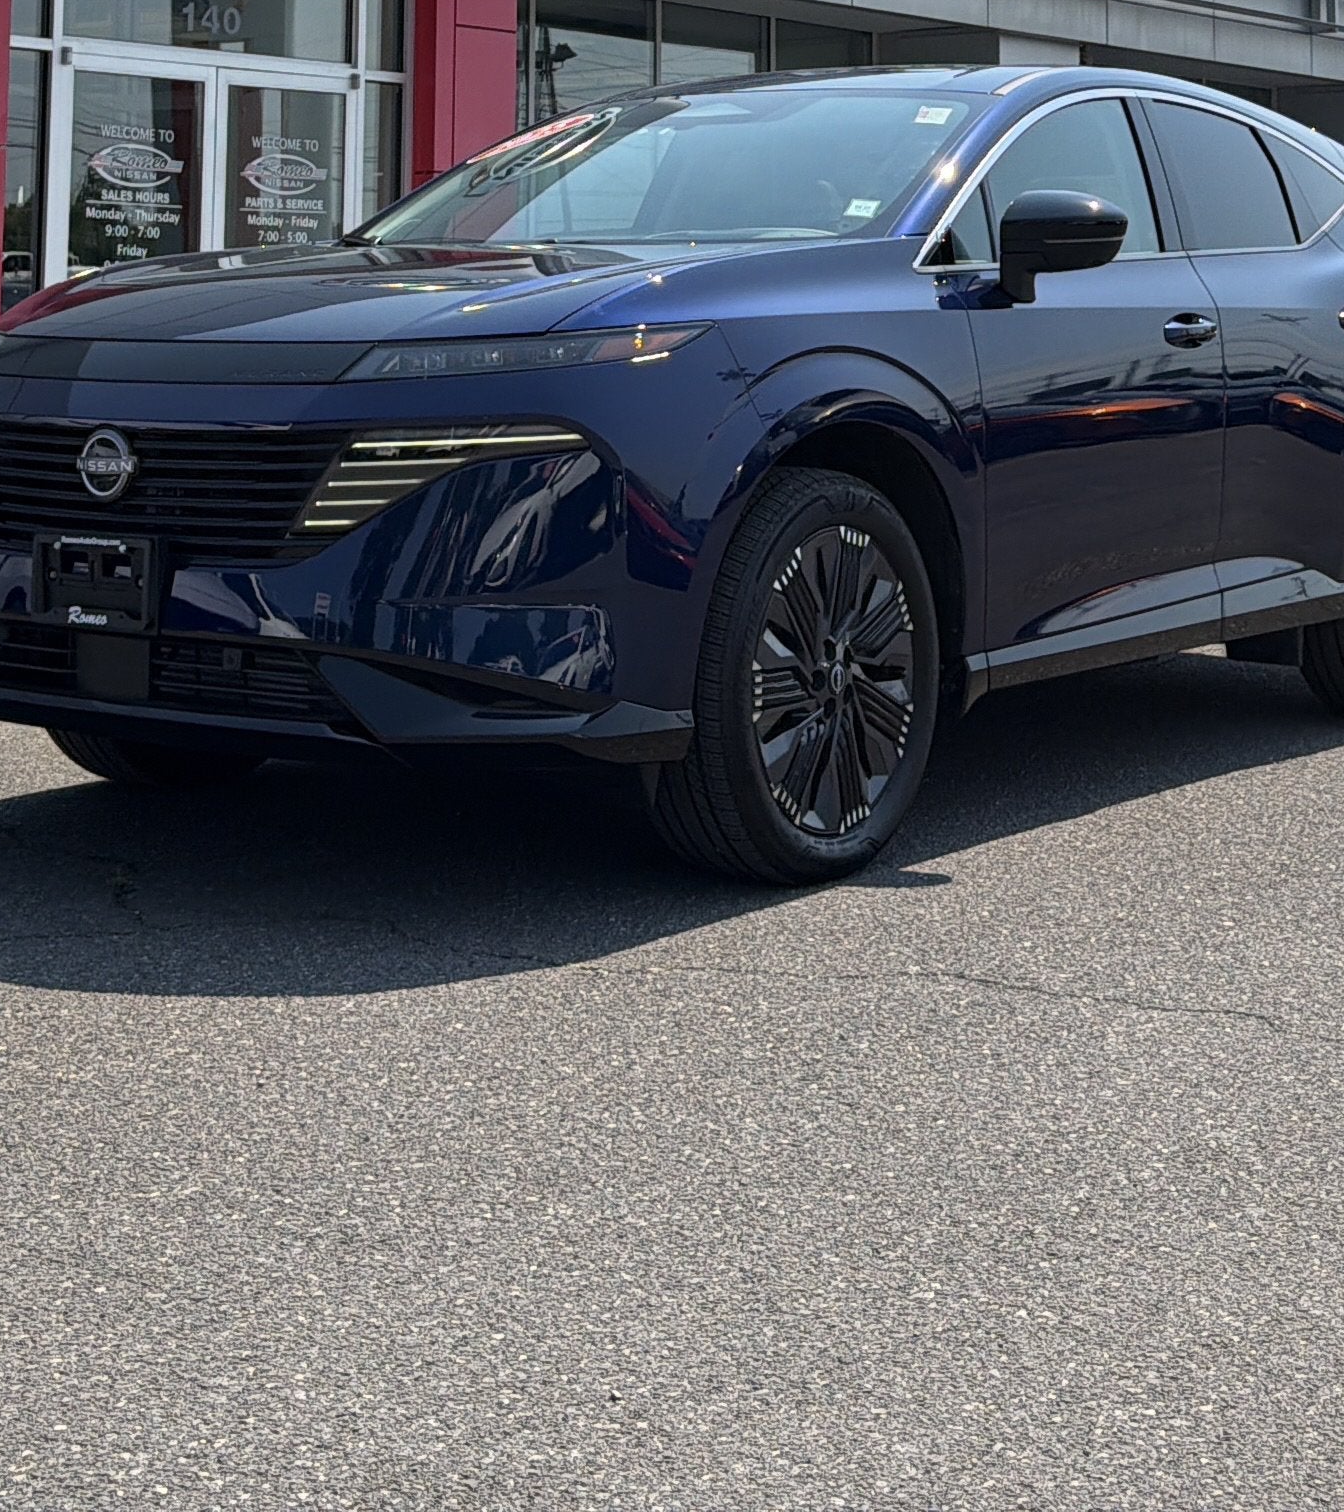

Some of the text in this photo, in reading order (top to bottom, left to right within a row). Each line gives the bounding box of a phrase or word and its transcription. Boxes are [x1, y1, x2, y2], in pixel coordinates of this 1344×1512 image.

[182, 2, 241, 35] 140
[100, 125, 175, 143] WELCOME TO
[252, 136, 319, 152] WELCOME TO
[106, 146, 168, 170] Romeo
[114, 168, 157, 180] NISSAN
[265, 178, 304, 188] NISSAN
[101, 189, 170, 204] SALES HOURS
[245, 197, 324, 210] PARTS & SERVICE
[86, 207, 127, 223] Monday
[135, 209, 181, 226] Thursday
[247, 214, 284, 228] Monday
[291, 216, 318, 229] Friday
[105, 224, 129, 237] 9:00
[138, 226, 161, 239] 7:00
[258, 231, 279, 242] 7:00
[287, 232, 308, 244] 5:00
[117, 243, 148, 259] Friday
[76, 457, 133, 472] NISSAN
[67, 606, 108, 626] Romeo
